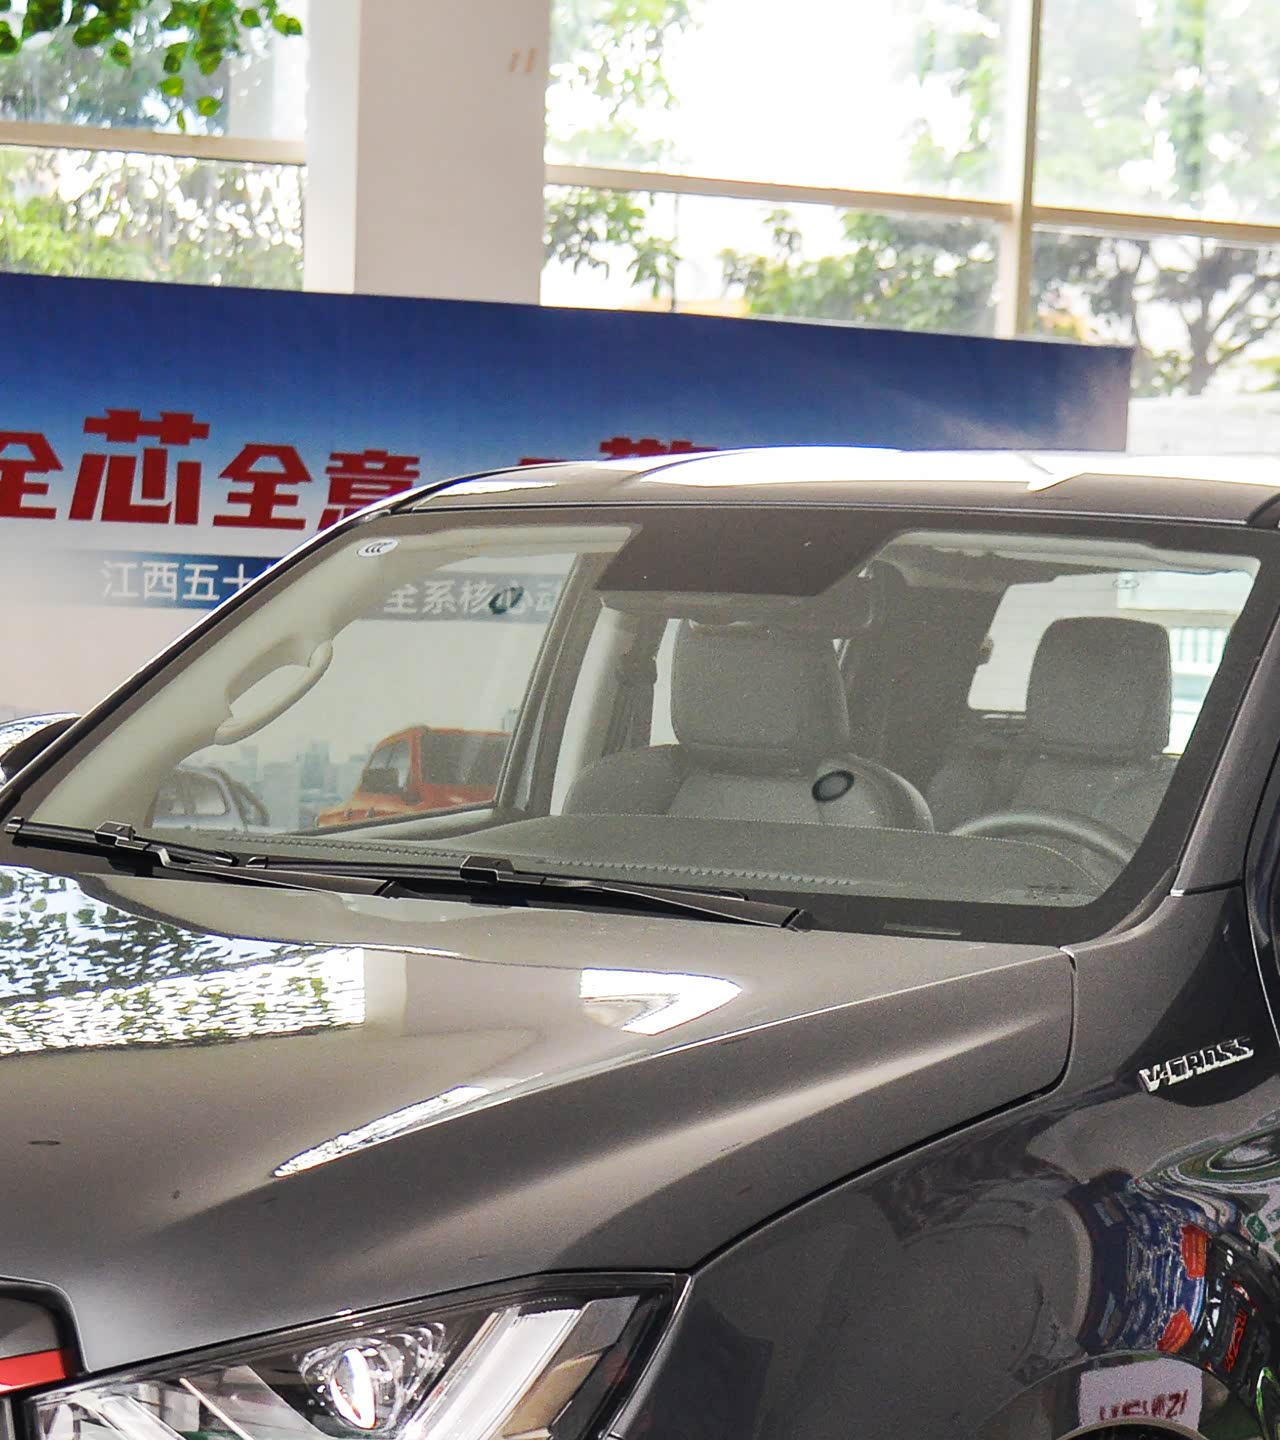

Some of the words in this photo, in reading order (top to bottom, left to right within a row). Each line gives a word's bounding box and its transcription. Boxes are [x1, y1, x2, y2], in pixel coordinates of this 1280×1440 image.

[101, 560, 274, 603] 江西五十
[1138, 1036, 1255, 1092] V-CROSS
